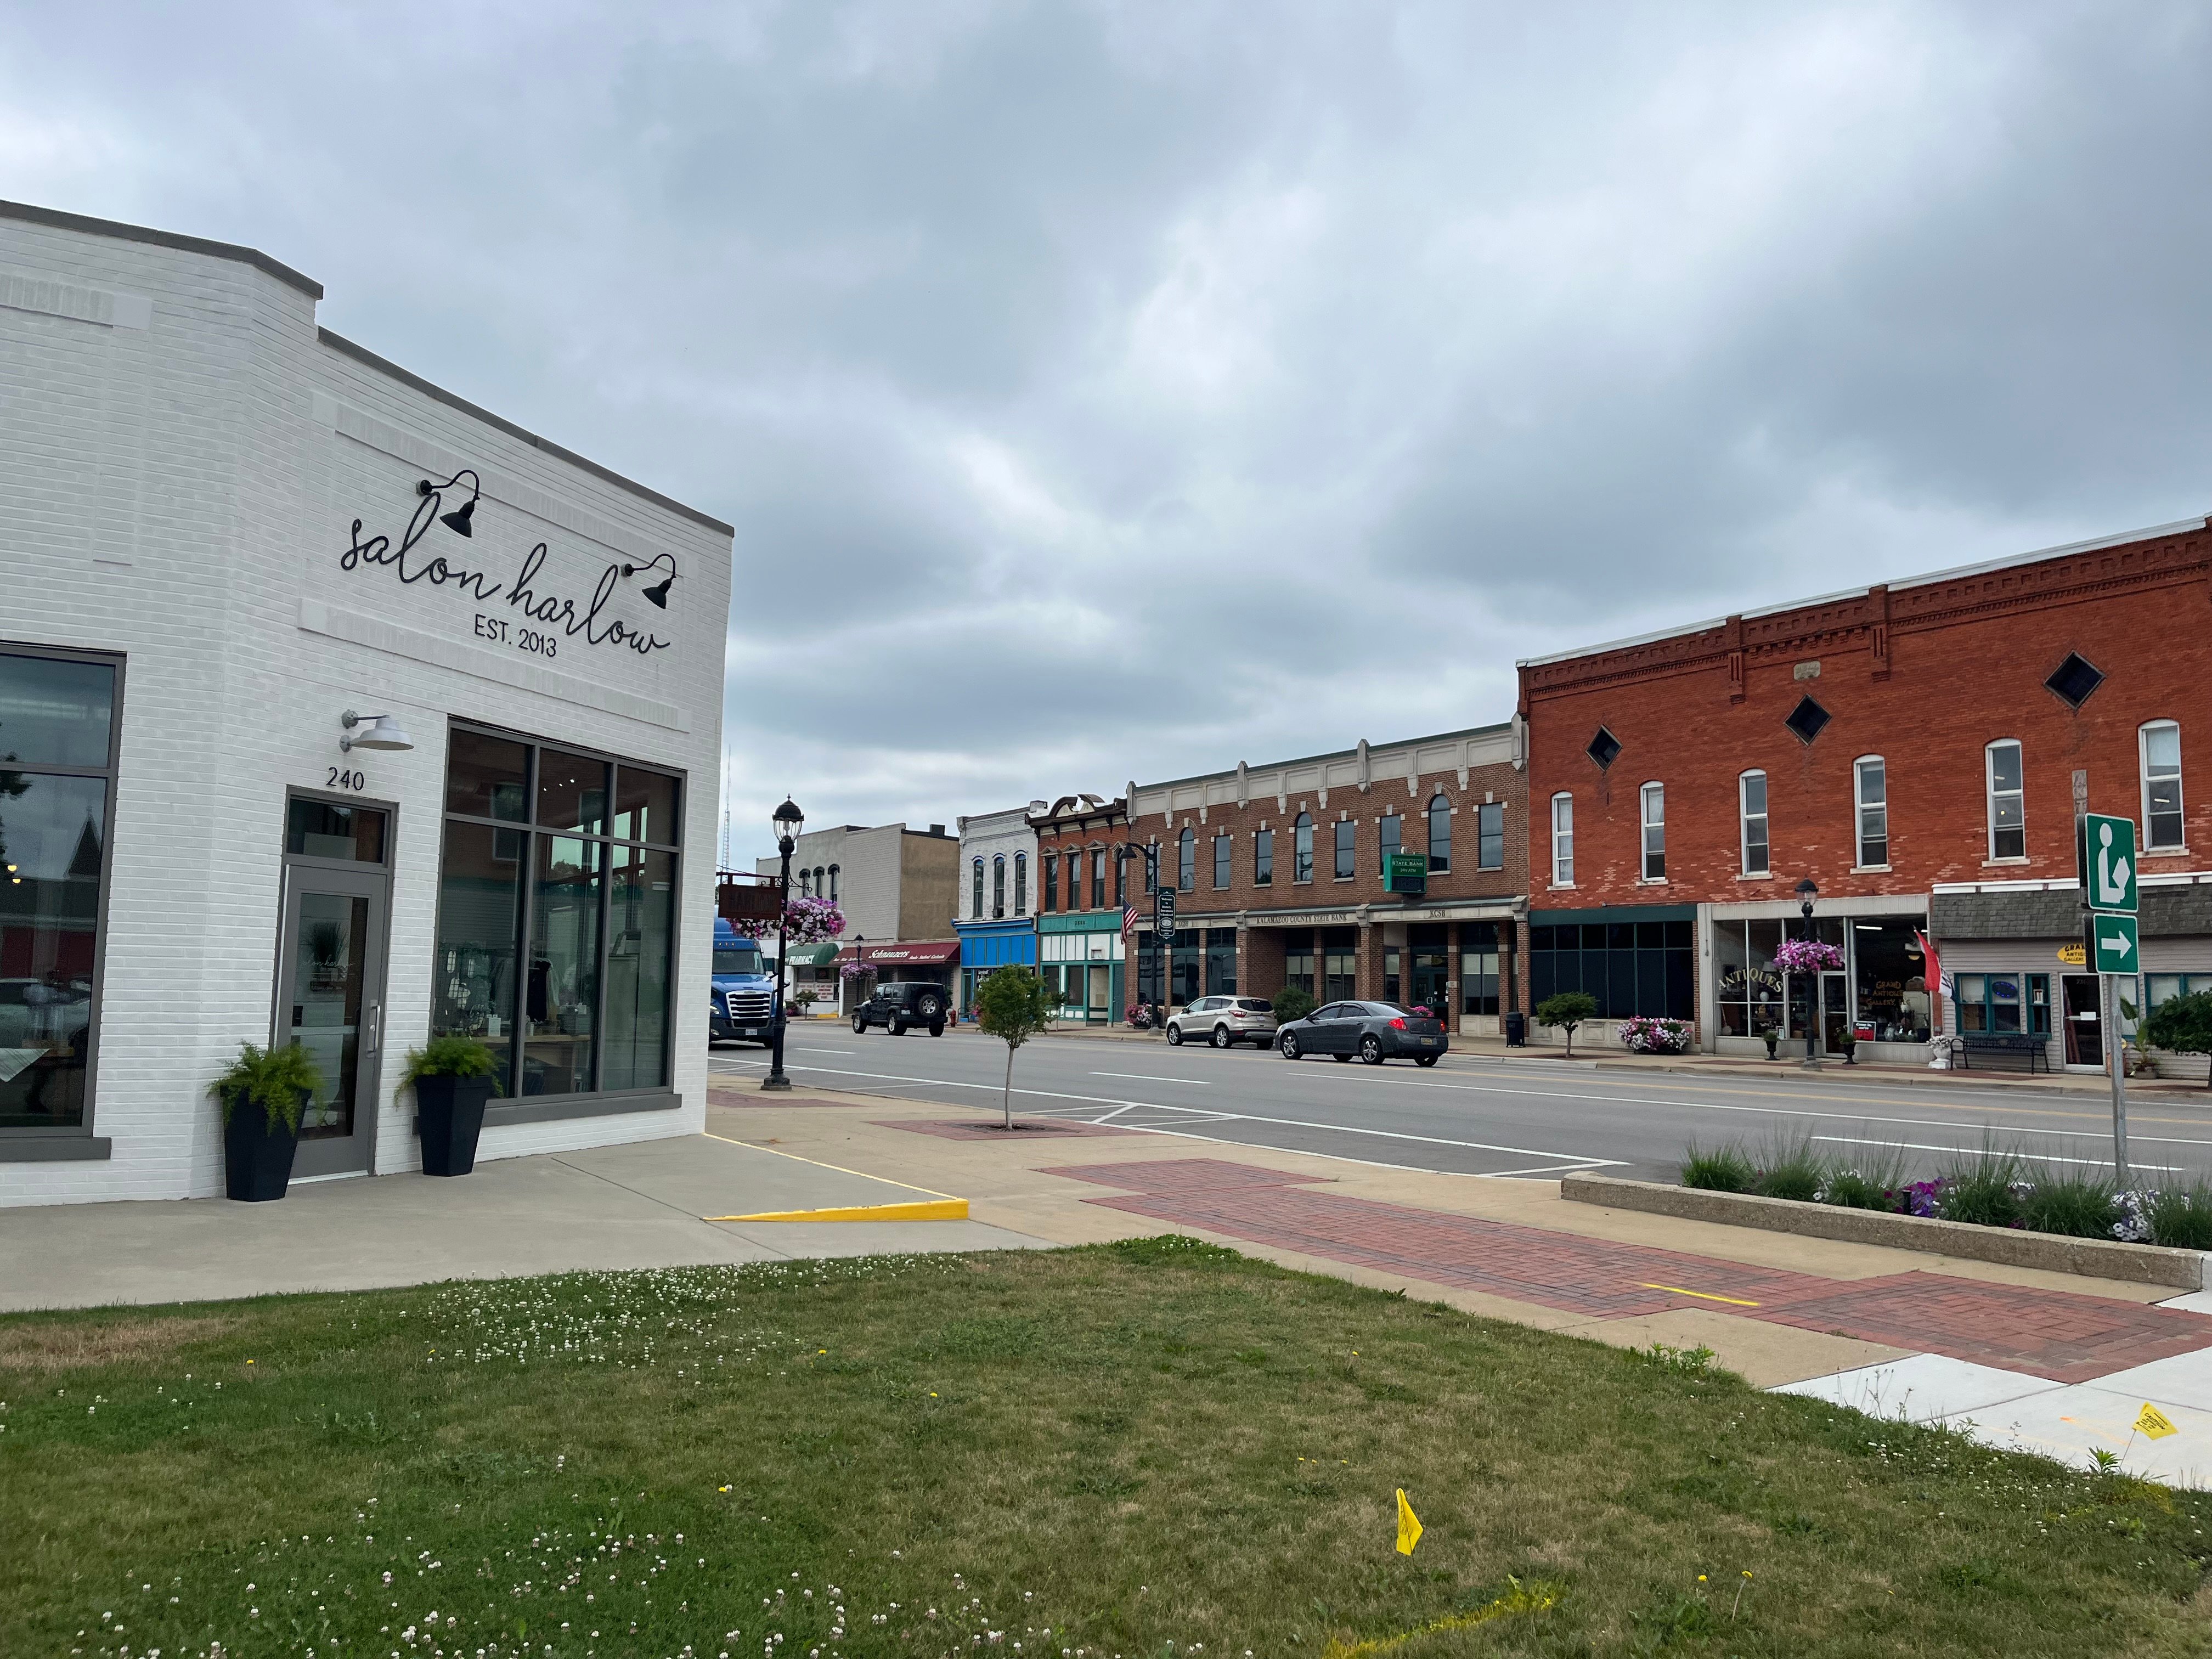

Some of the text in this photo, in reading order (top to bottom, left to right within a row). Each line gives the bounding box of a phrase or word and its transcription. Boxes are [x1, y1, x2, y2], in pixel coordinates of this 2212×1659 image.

[341, 491, 670, 654] salon harlow
[474, 613, 557, 657] EST. 2013
[325, 766, 364, 791] 240
[789, 955, 815, 965] PHARMACY
[868, 950, 911, 959] Schnauzers
[1719, 968, 1784, 992] ANTIQUES
[1876, 980, 1901, 989] GRAND
